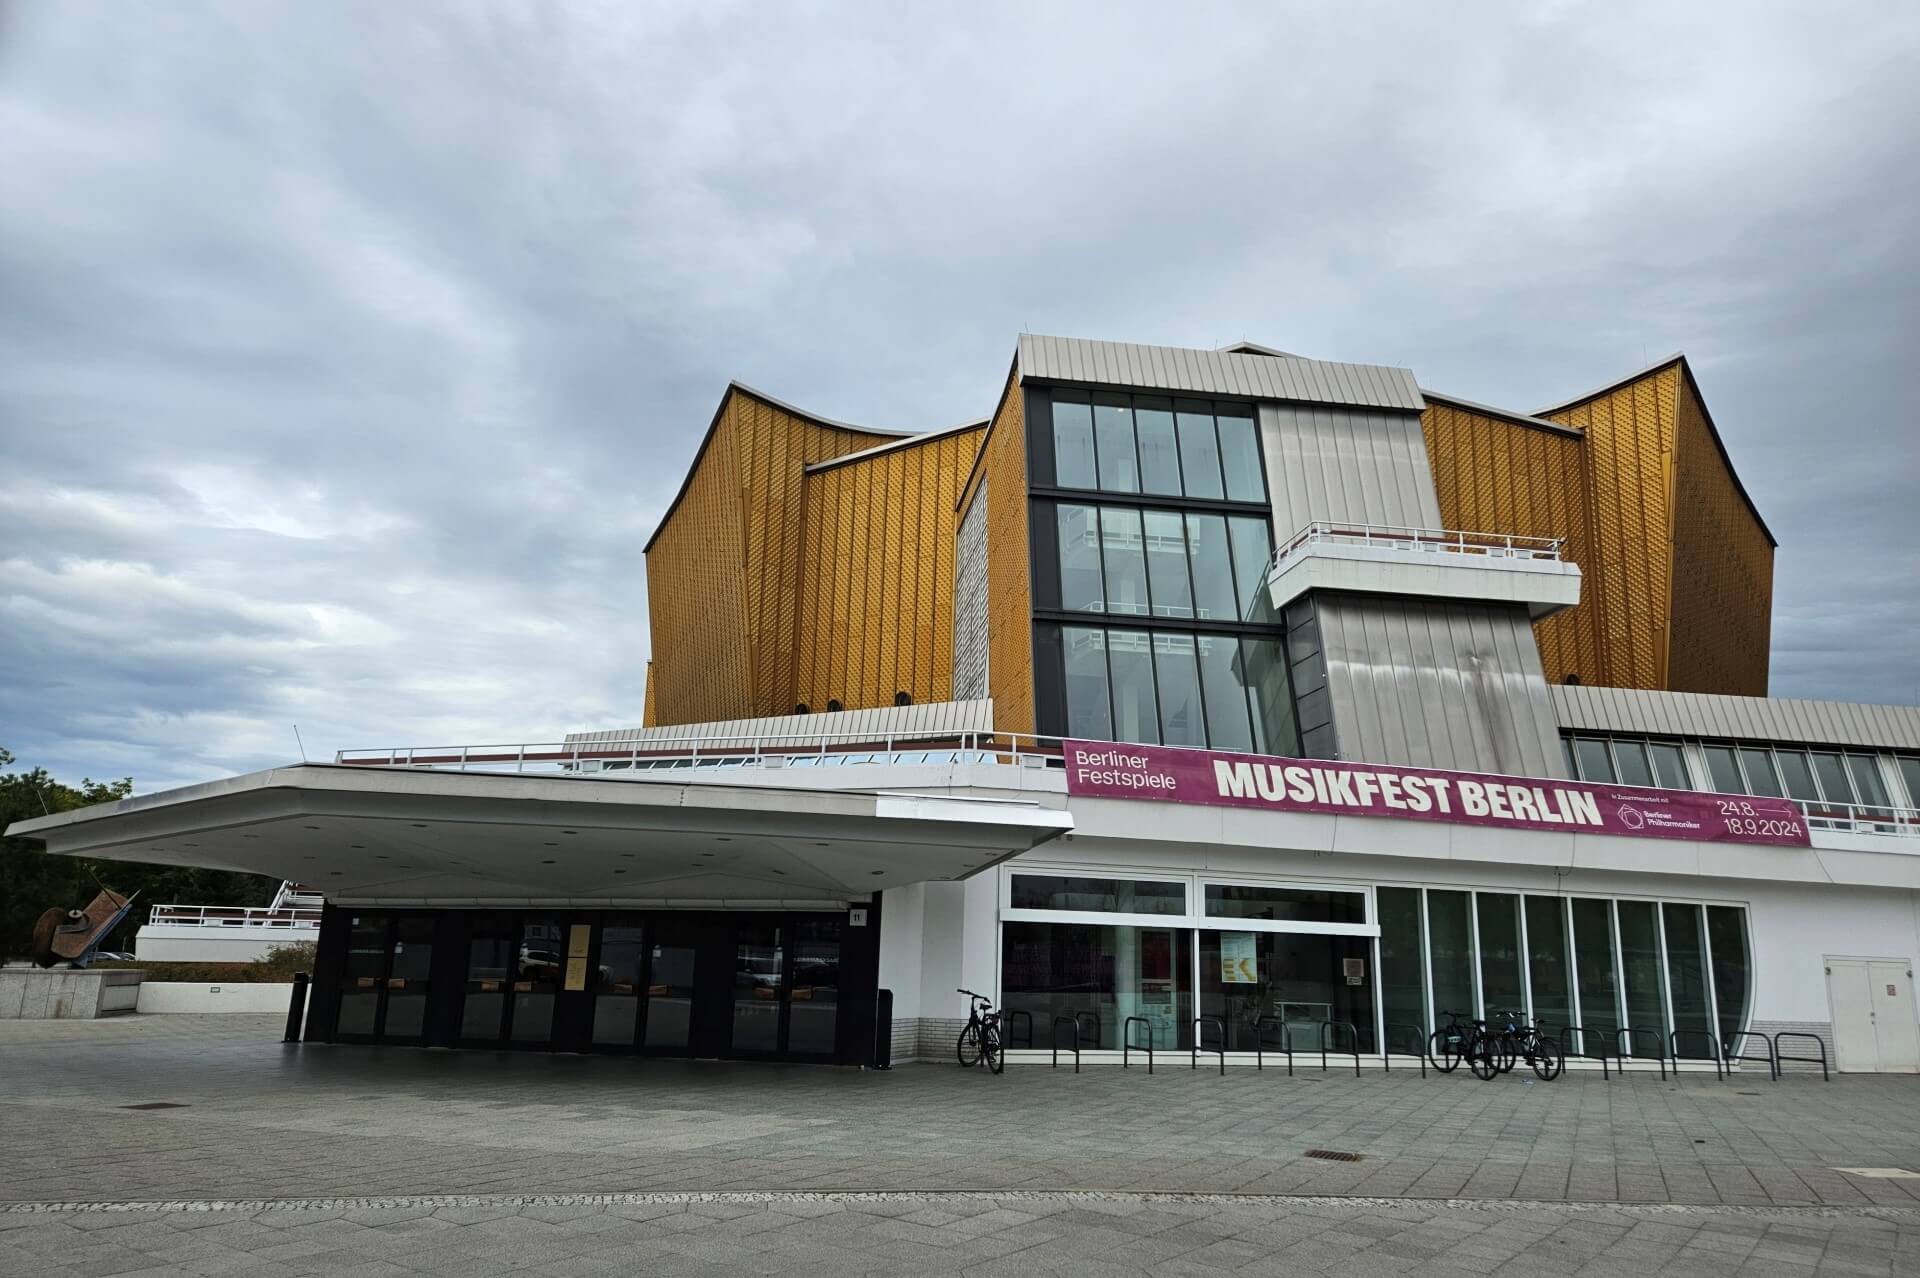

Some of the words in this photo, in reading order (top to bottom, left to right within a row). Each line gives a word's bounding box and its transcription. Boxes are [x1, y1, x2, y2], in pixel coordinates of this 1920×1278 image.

[1075, 750, 1149, 769] Berliner
[1078, 768, 1177, 790] Festspiele
[1213, 759, 1451, 813] MUSIKFEST
[1456, 780, 1604, 826] BERLIN
[1643, 810, 1672, 819] Berliner
[1717, 800, 1760, 817] 24.8.
[1647, 818, 1700, 829] Philharmoniker
[1723, 818, 1802, 838] 18.9.2024
